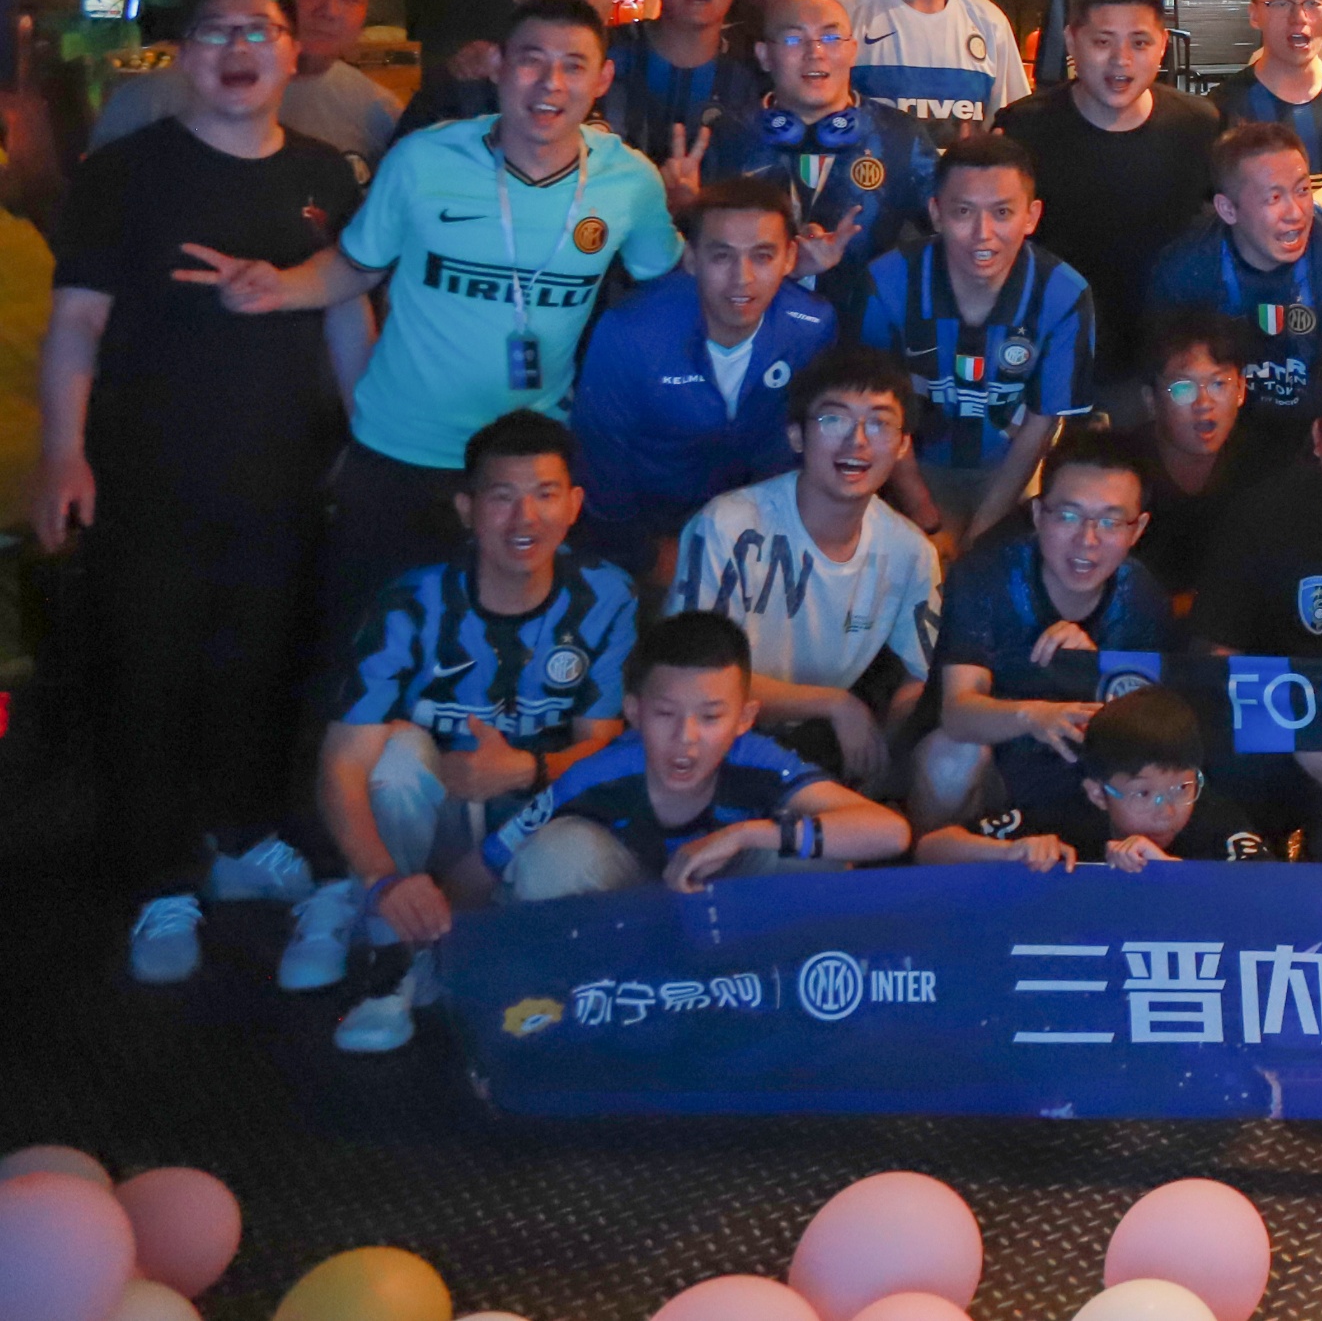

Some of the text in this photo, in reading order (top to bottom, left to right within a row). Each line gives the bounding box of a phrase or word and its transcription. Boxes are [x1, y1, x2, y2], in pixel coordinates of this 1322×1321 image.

[571, 973, 762, 1025] 苏宁易购
[870, 970, 937, 1003] INTER
